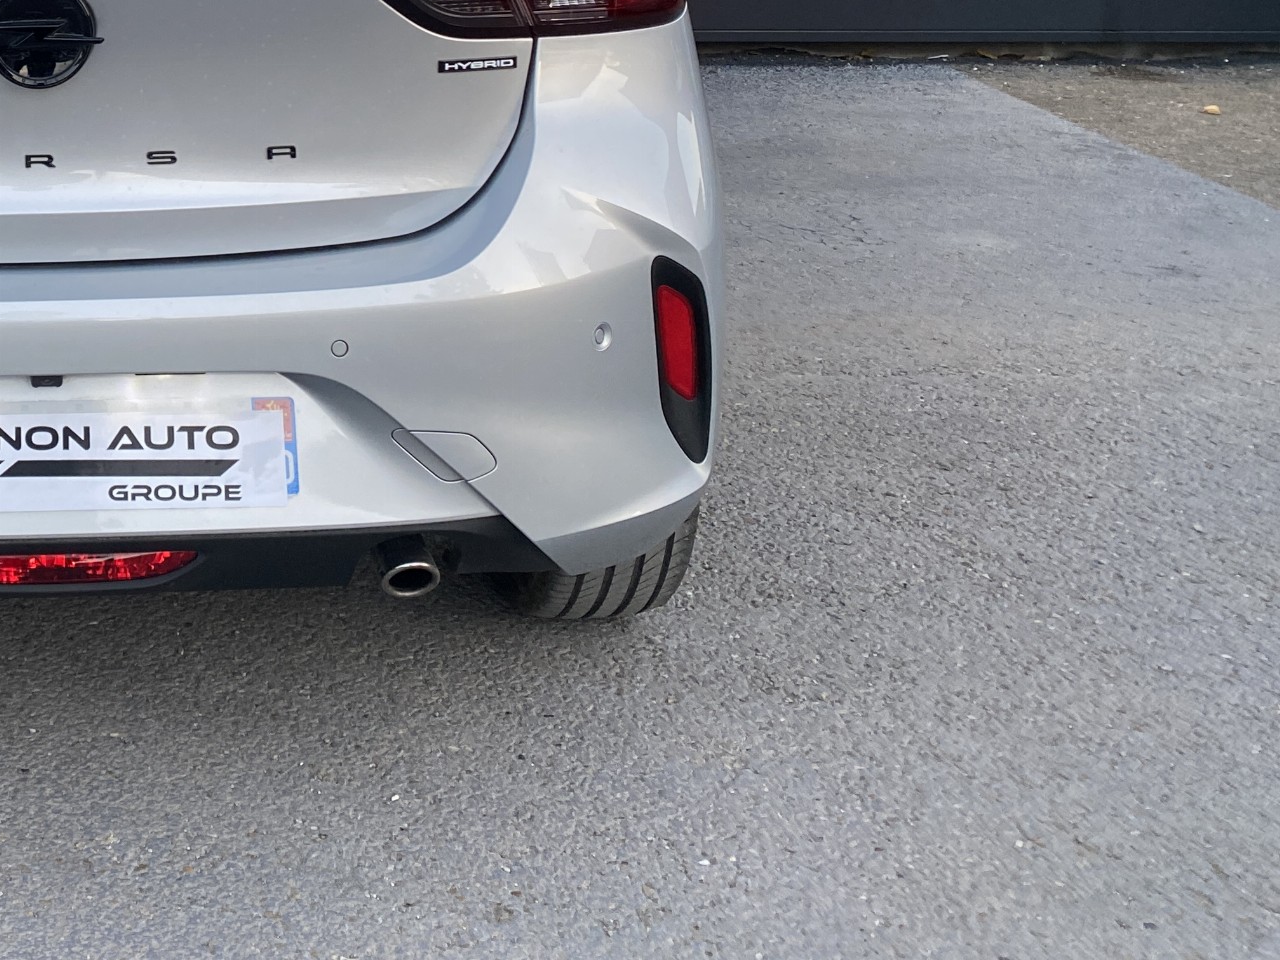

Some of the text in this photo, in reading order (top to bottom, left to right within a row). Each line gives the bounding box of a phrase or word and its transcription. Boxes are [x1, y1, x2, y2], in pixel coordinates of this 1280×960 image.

[444, 58, 515, 71] HYBRID
[107, 425, 240, 452] AUTO
[108, 484, 243, 502] GROUPE
